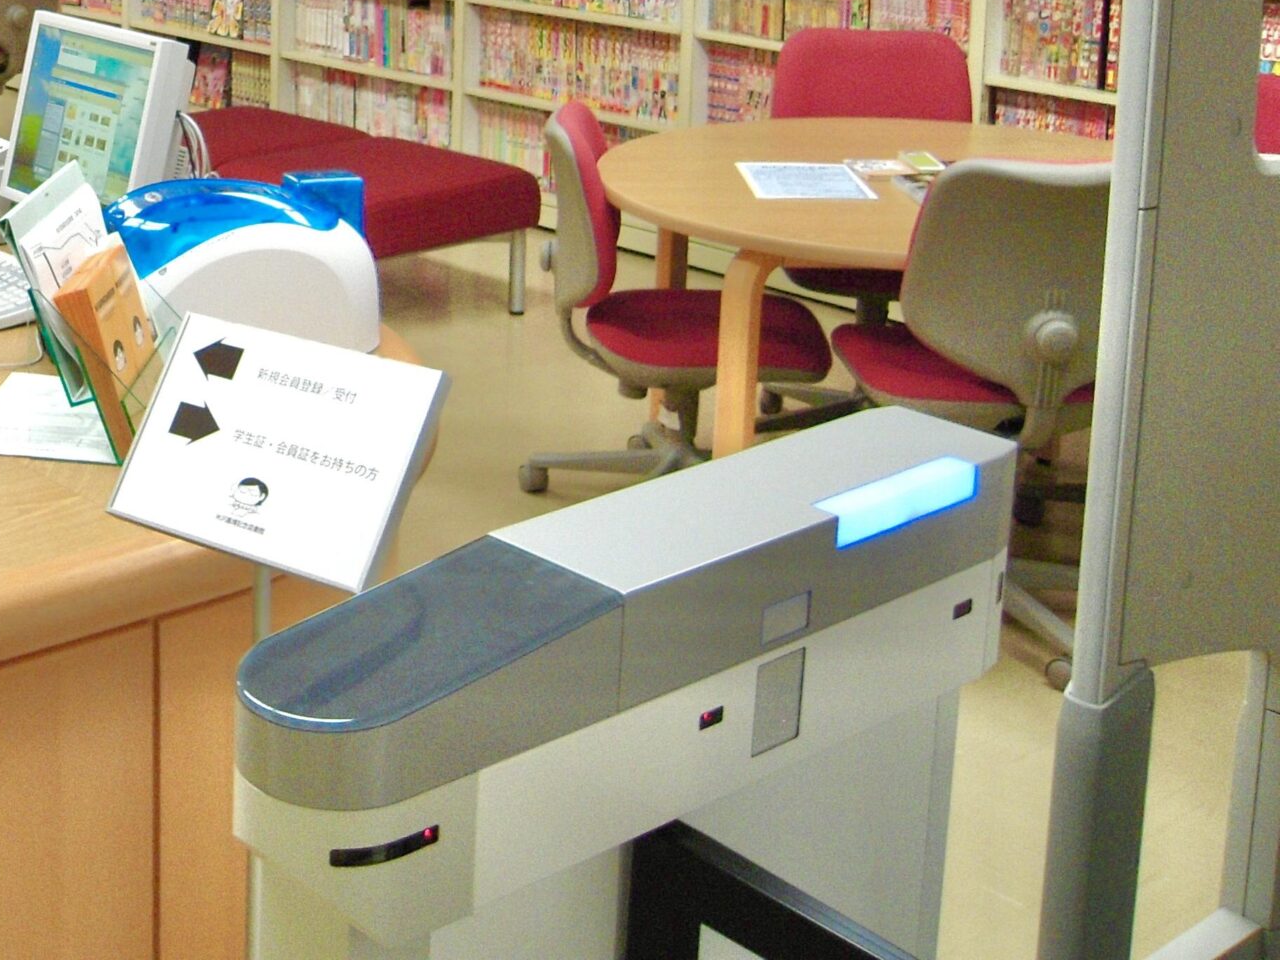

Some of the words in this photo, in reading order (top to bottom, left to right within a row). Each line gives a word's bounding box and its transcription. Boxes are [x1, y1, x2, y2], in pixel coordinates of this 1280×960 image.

[233, 428, 380, 482] 学生証・会員証をお持ちの方
